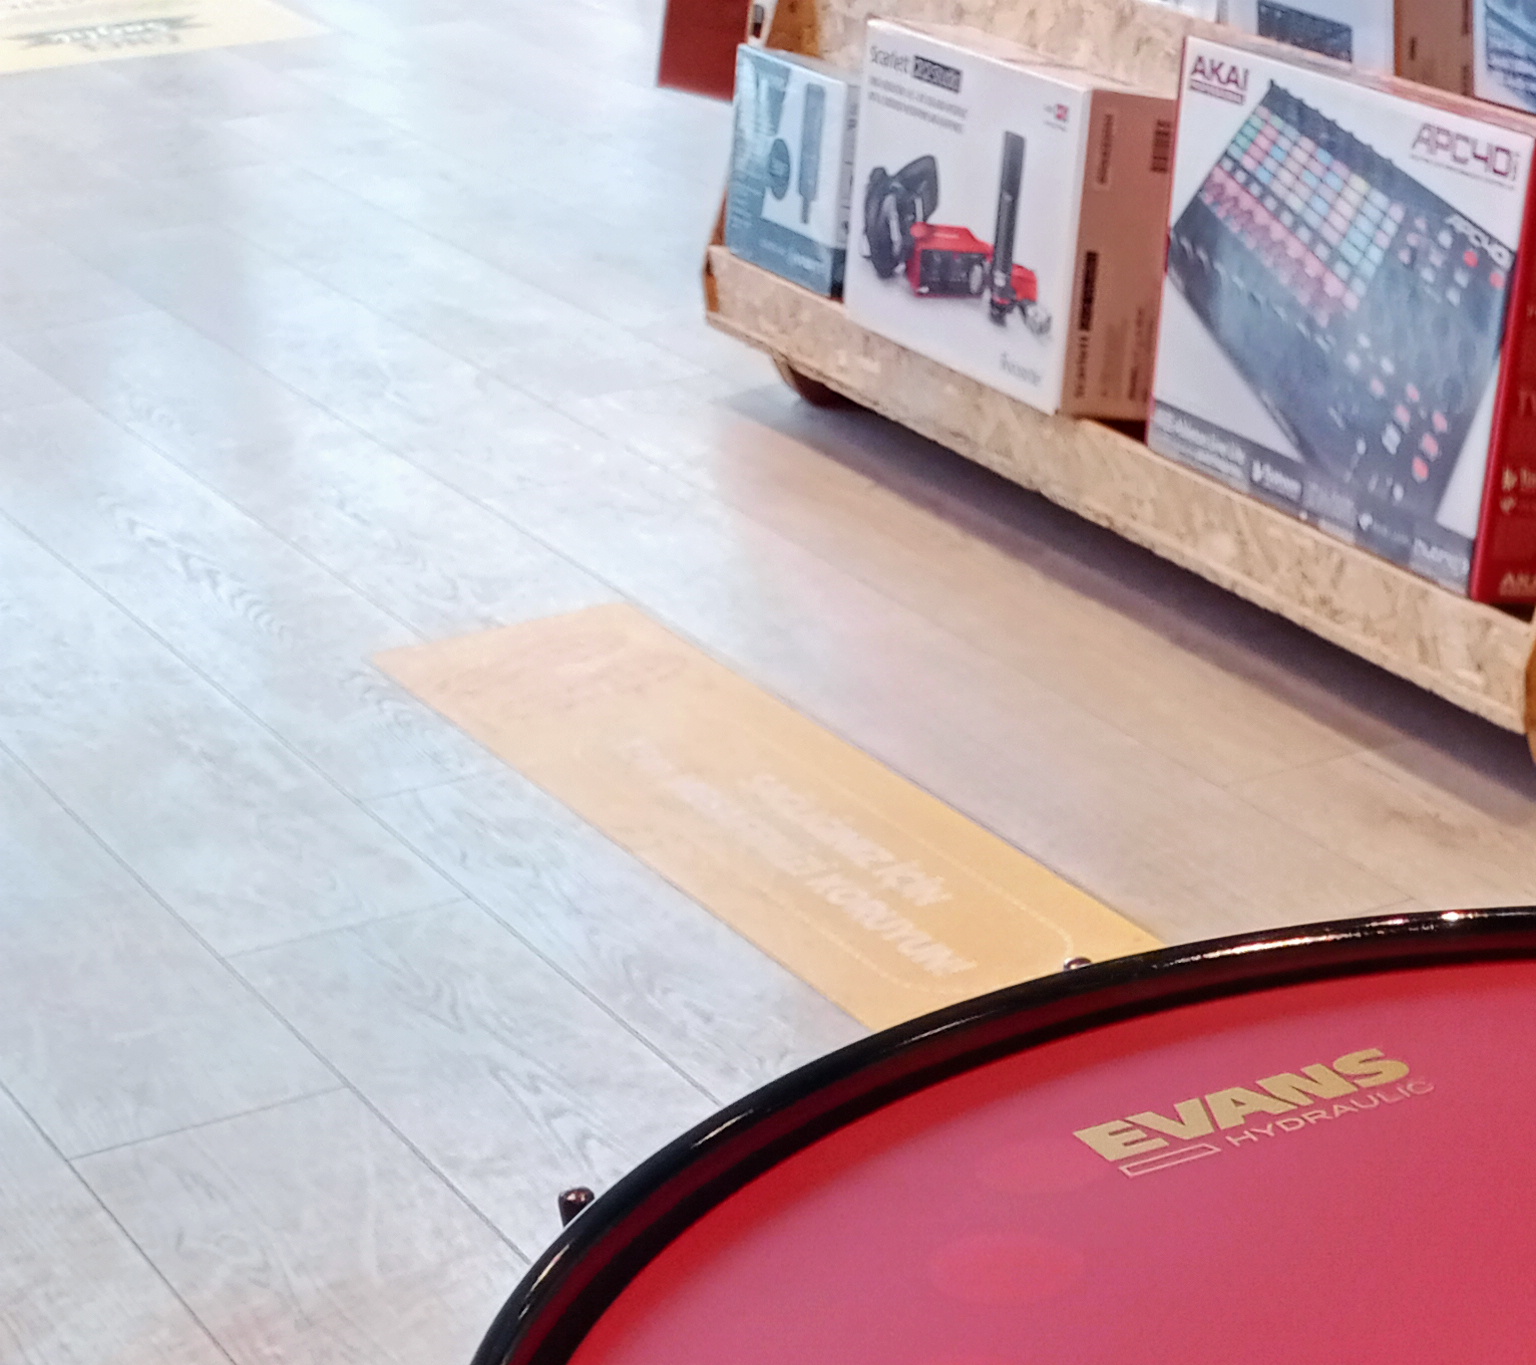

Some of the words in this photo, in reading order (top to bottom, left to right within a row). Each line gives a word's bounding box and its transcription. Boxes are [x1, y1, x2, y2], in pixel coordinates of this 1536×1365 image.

[1190, 55, 1248, 91] AKAI
[1072, 1047, 1410, 1162] EVANS
[1225, 1079, 1435, 1148] HYDRAULIC
